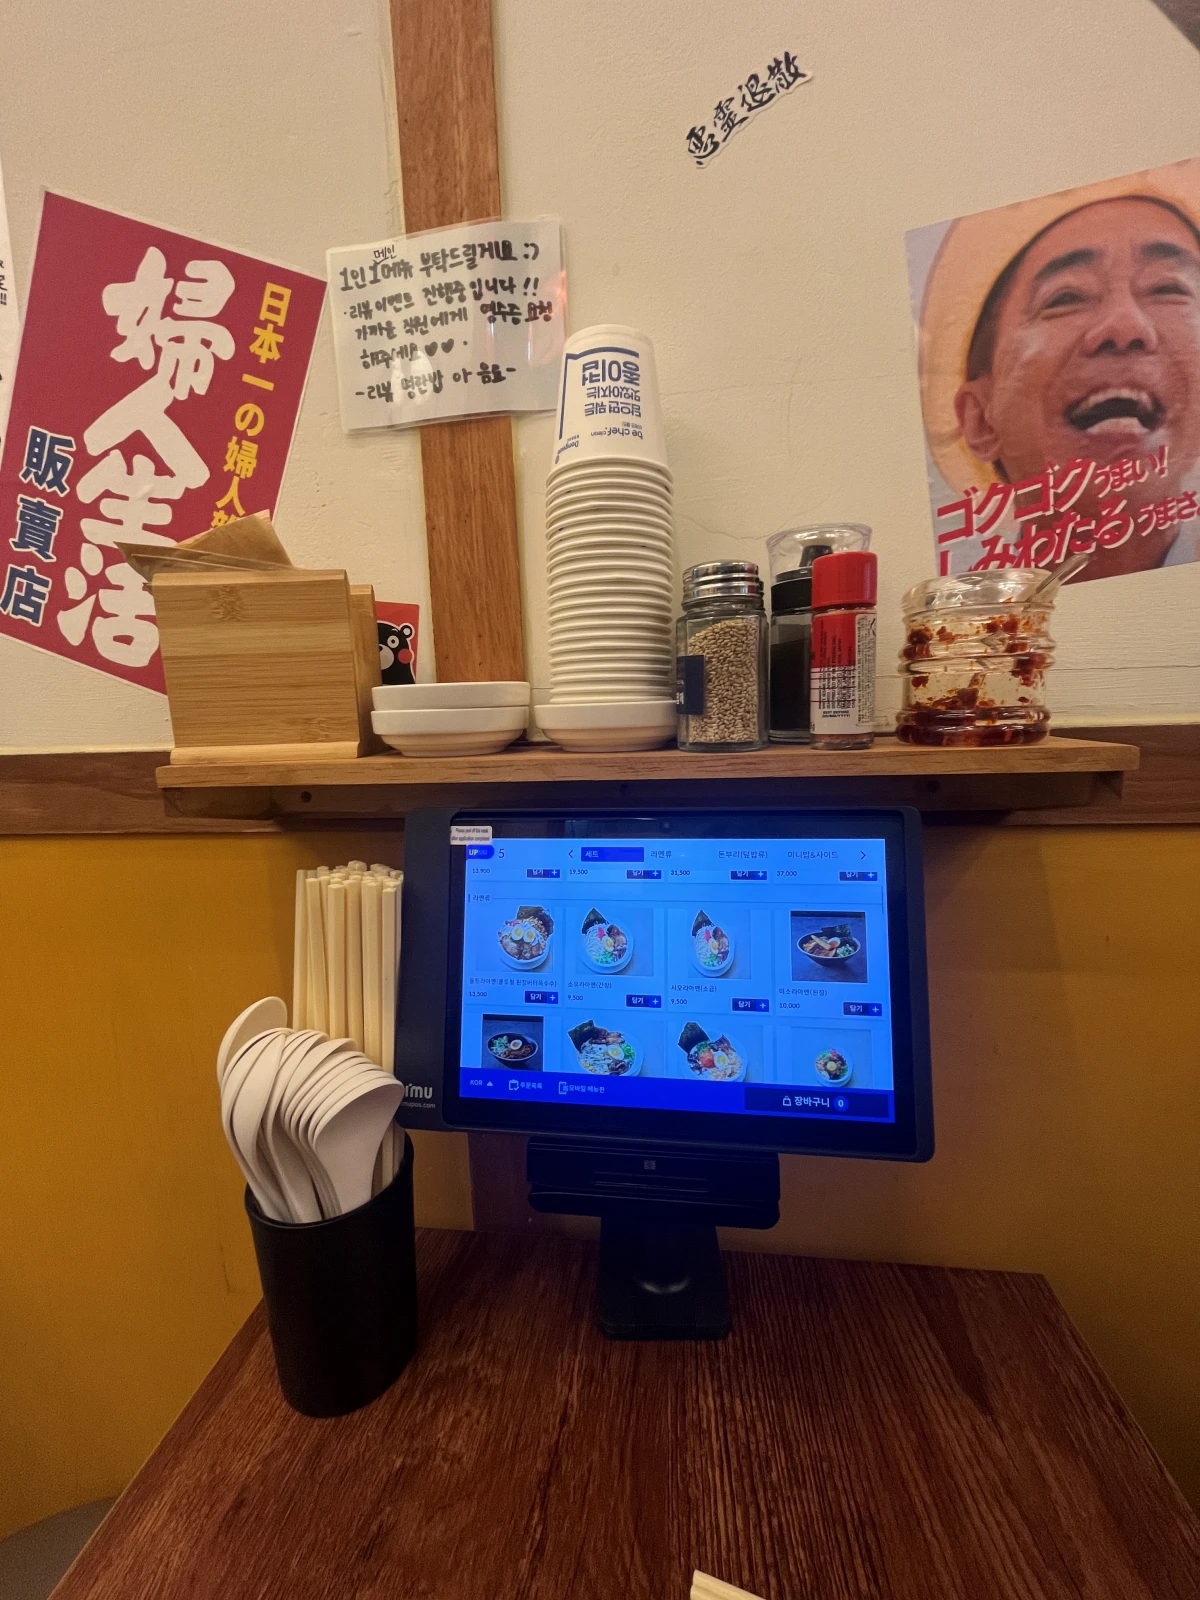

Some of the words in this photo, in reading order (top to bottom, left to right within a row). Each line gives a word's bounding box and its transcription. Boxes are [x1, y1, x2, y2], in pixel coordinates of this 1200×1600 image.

[373, 244, 396, 259] 메인
[419, 239, 518, 277] 부탁드릴게요
[355, 320, 397, 341] 가까운
[402, 307, 469, 336] 직원에게
[582, 359, 641, 386] 종이컵
[586, 385, 641, 402] 맛있어지는
[584, 401, 607, 417] 뭐든
[608, 400, 642, 418] 담으면
[631, 429, 643, 440] be
[937, 457, 1097, 545] ゴクゴク
[1136, 489, 1200, 538] うまさ
[498, 849, 505, 858] 5
[650, 850, 672, 859] 라멘류
[718, 850, 768, 860] 돈부리(덮밥류)
[787, 850, 839, 860] 미니밥&사이드
[569, 868, 588, 876] 19,500
[670, 869, 691, 877] 31,500
[530, 993, 542, 1001] 담기
[631, 997, 644, 1005] 담기
[738, 1000, 751, 1008] 담기
[779, 1002, 801, 1010] 10,000
[849, 1004, 863, 1013] 담기
[470, 1079, 483, 1087] KOR
[794, 1096, 830, 1108] 장바구니
[838, 1099, 844, 1107] 0
